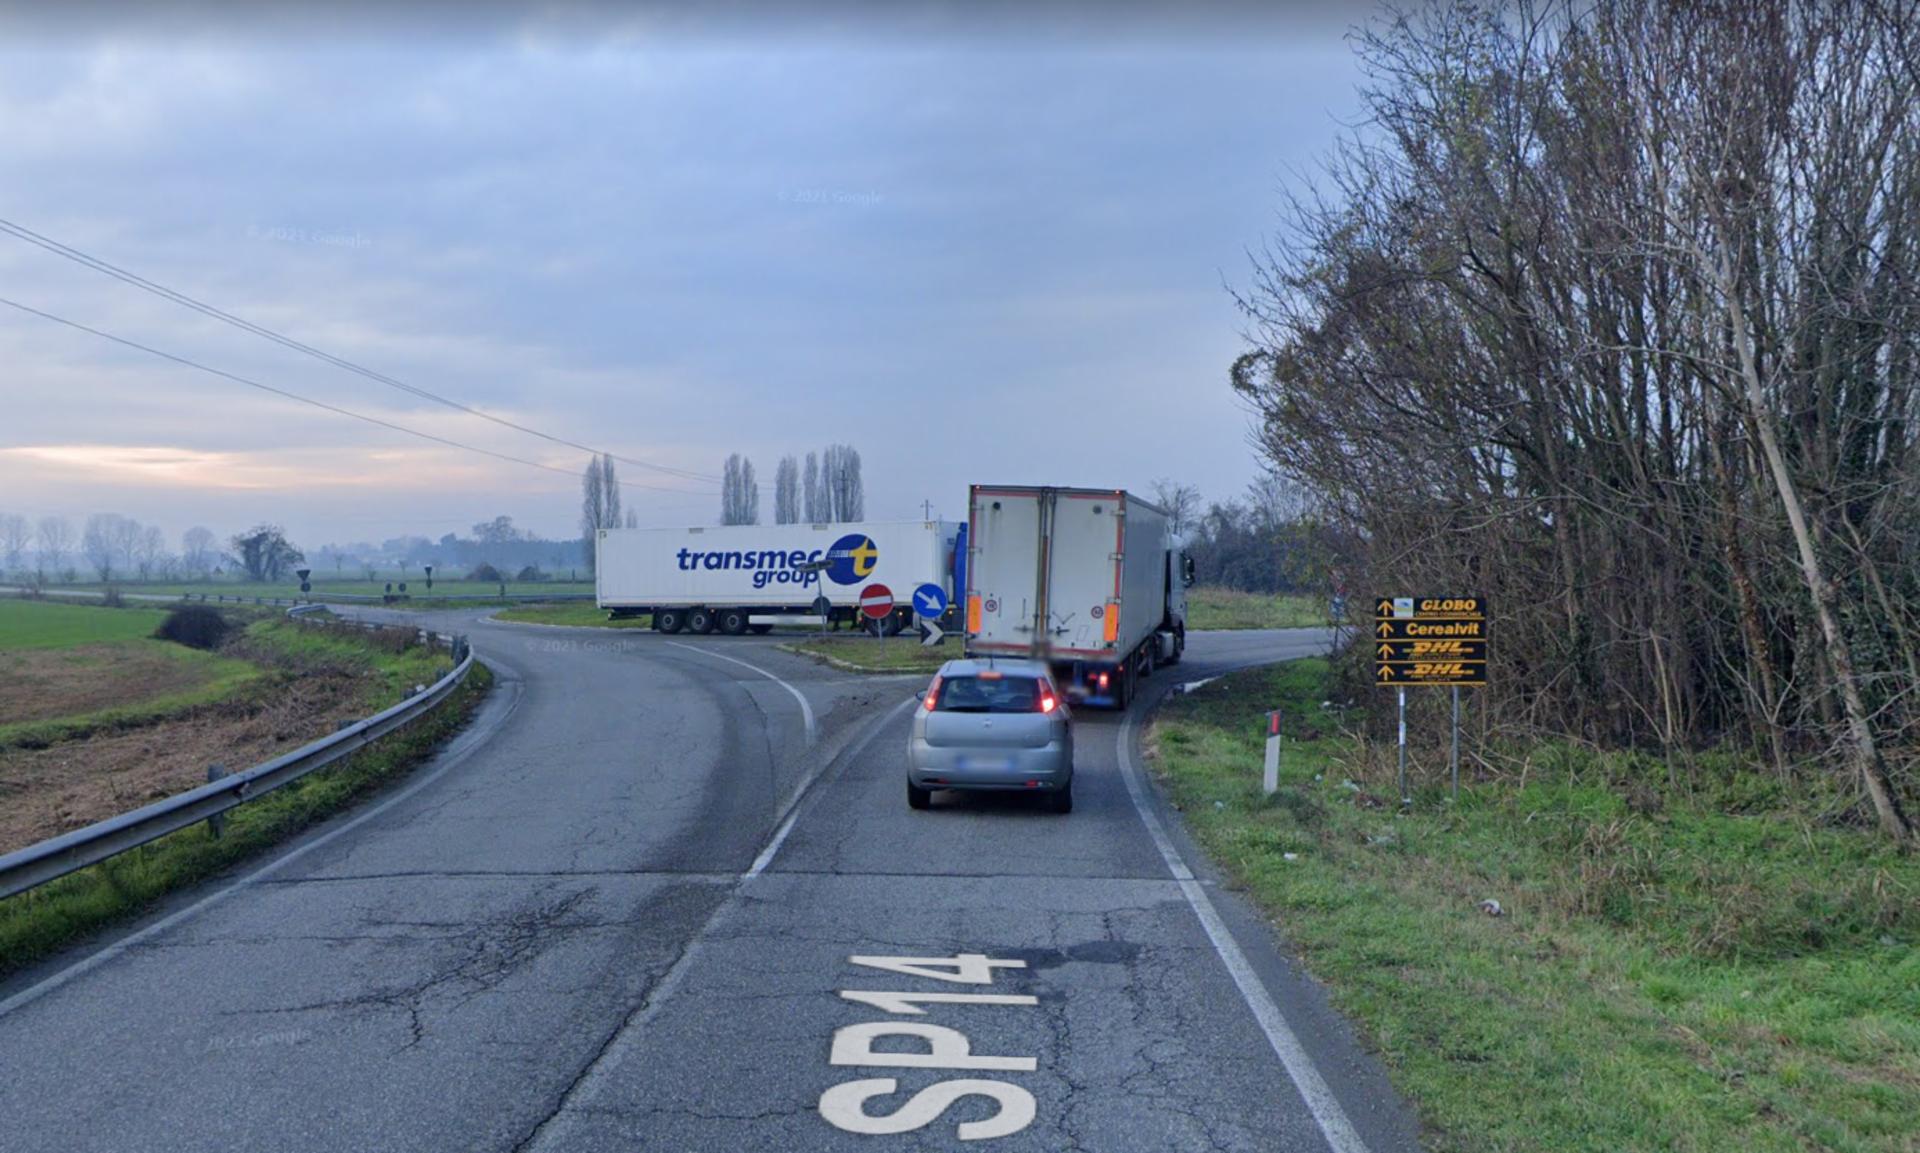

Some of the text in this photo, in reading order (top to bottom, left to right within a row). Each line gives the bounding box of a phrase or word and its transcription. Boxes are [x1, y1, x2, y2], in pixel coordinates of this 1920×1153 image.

[677, 548, 823, 570] transmec
[753, 570, 819, 589] group
[1421, 599, 1476, 611] GLOBO
[1406, 623, 1479, 635] Cerealvit
[1413, 641, 1464, 653] DHL
[1414, 663, 1465, 675] DHL
[818, 953, 1039, 1141] SP14
